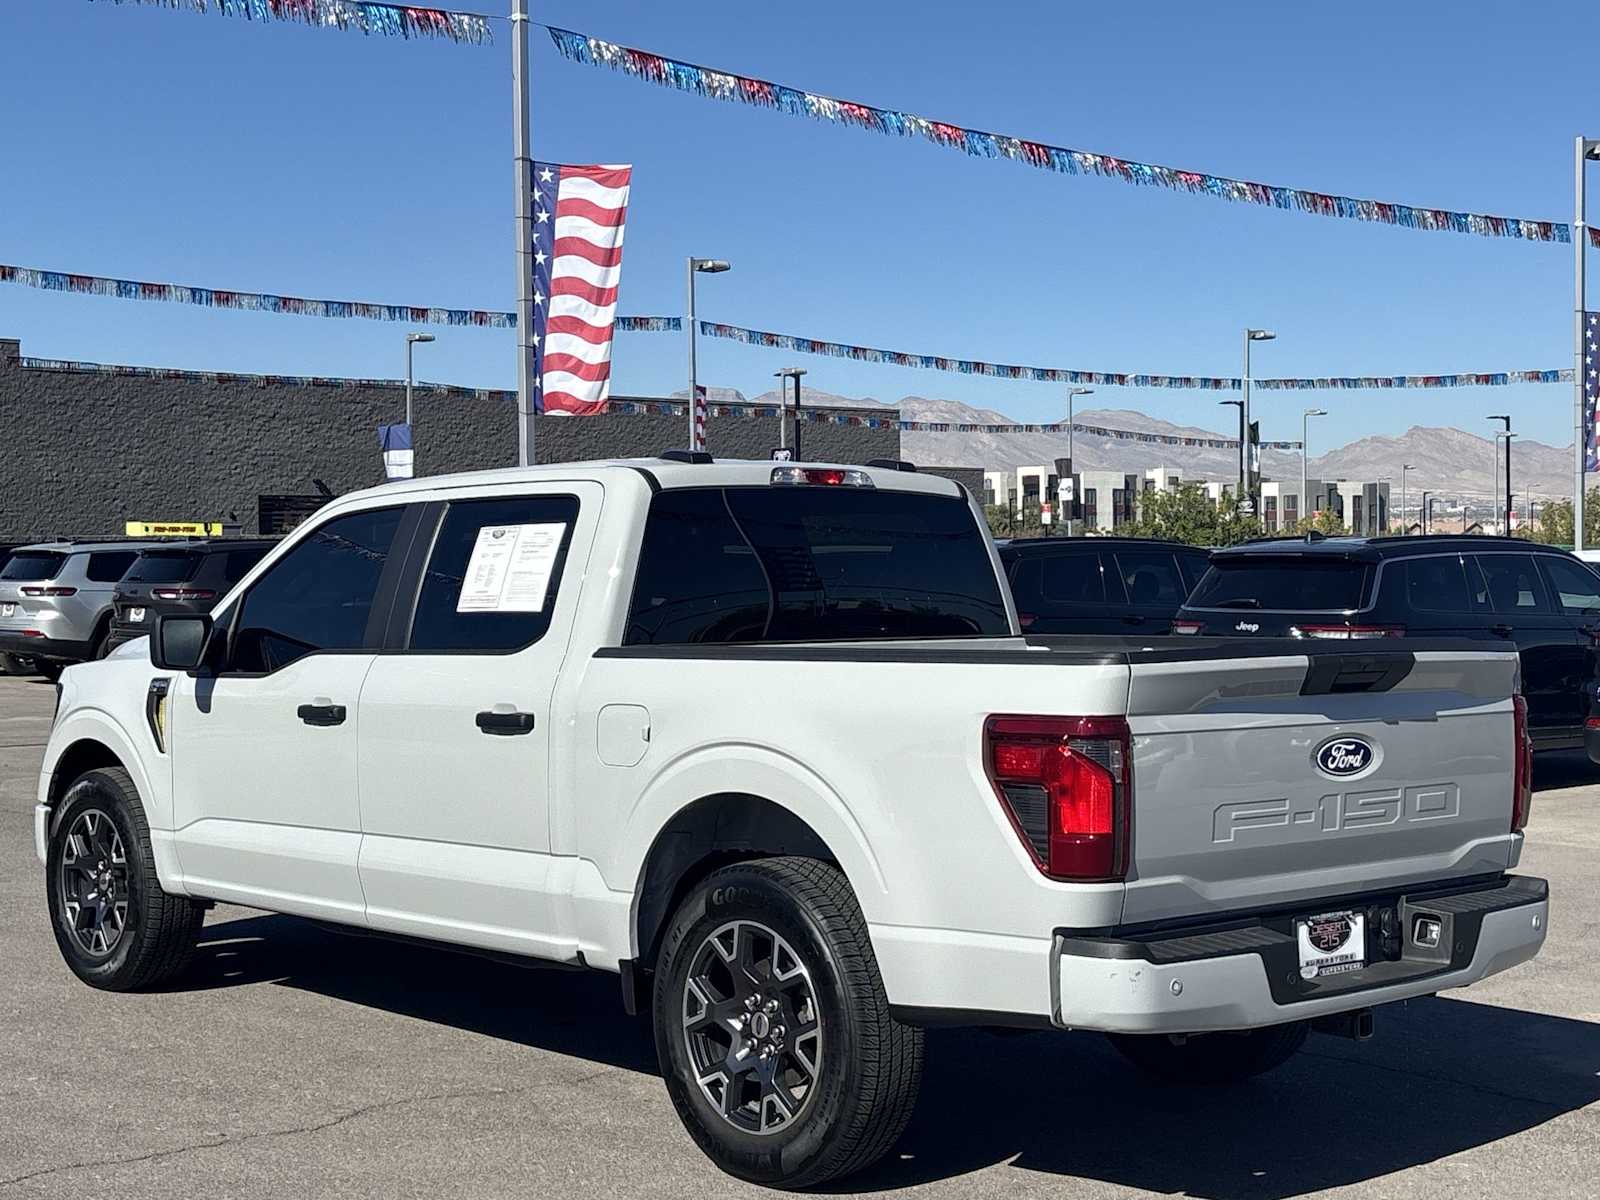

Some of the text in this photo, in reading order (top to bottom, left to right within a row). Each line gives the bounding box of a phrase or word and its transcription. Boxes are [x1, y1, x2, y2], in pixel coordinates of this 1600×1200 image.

[1235, 621, 1259, 632] Jeep
[1327, 744, 1364, 769] Ford
[1212, 782, 1460, 843] F-150
[1311, 921, 1346, 934] DESERT
[1320, 933, 1340, 948] 215
